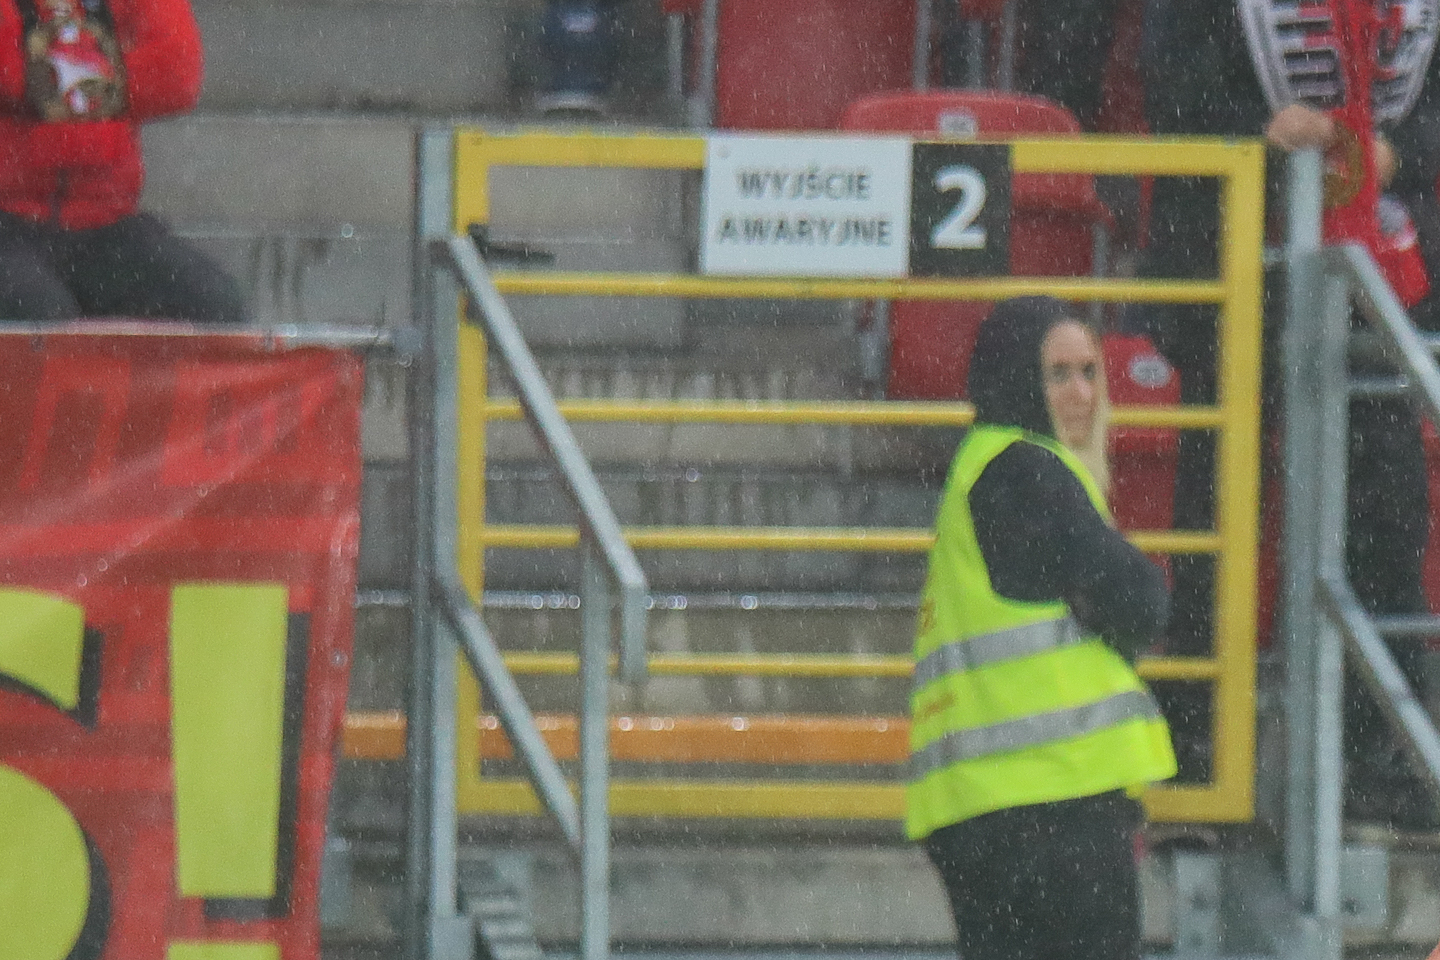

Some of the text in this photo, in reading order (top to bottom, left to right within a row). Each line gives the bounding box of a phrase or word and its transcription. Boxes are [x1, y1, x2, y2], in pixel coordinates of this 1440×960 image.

[736, 163, 872, 200] WYJŚCIE
[929, 163, 988, 250] 2
[719, 214, 894, 246] AWARYJNE
